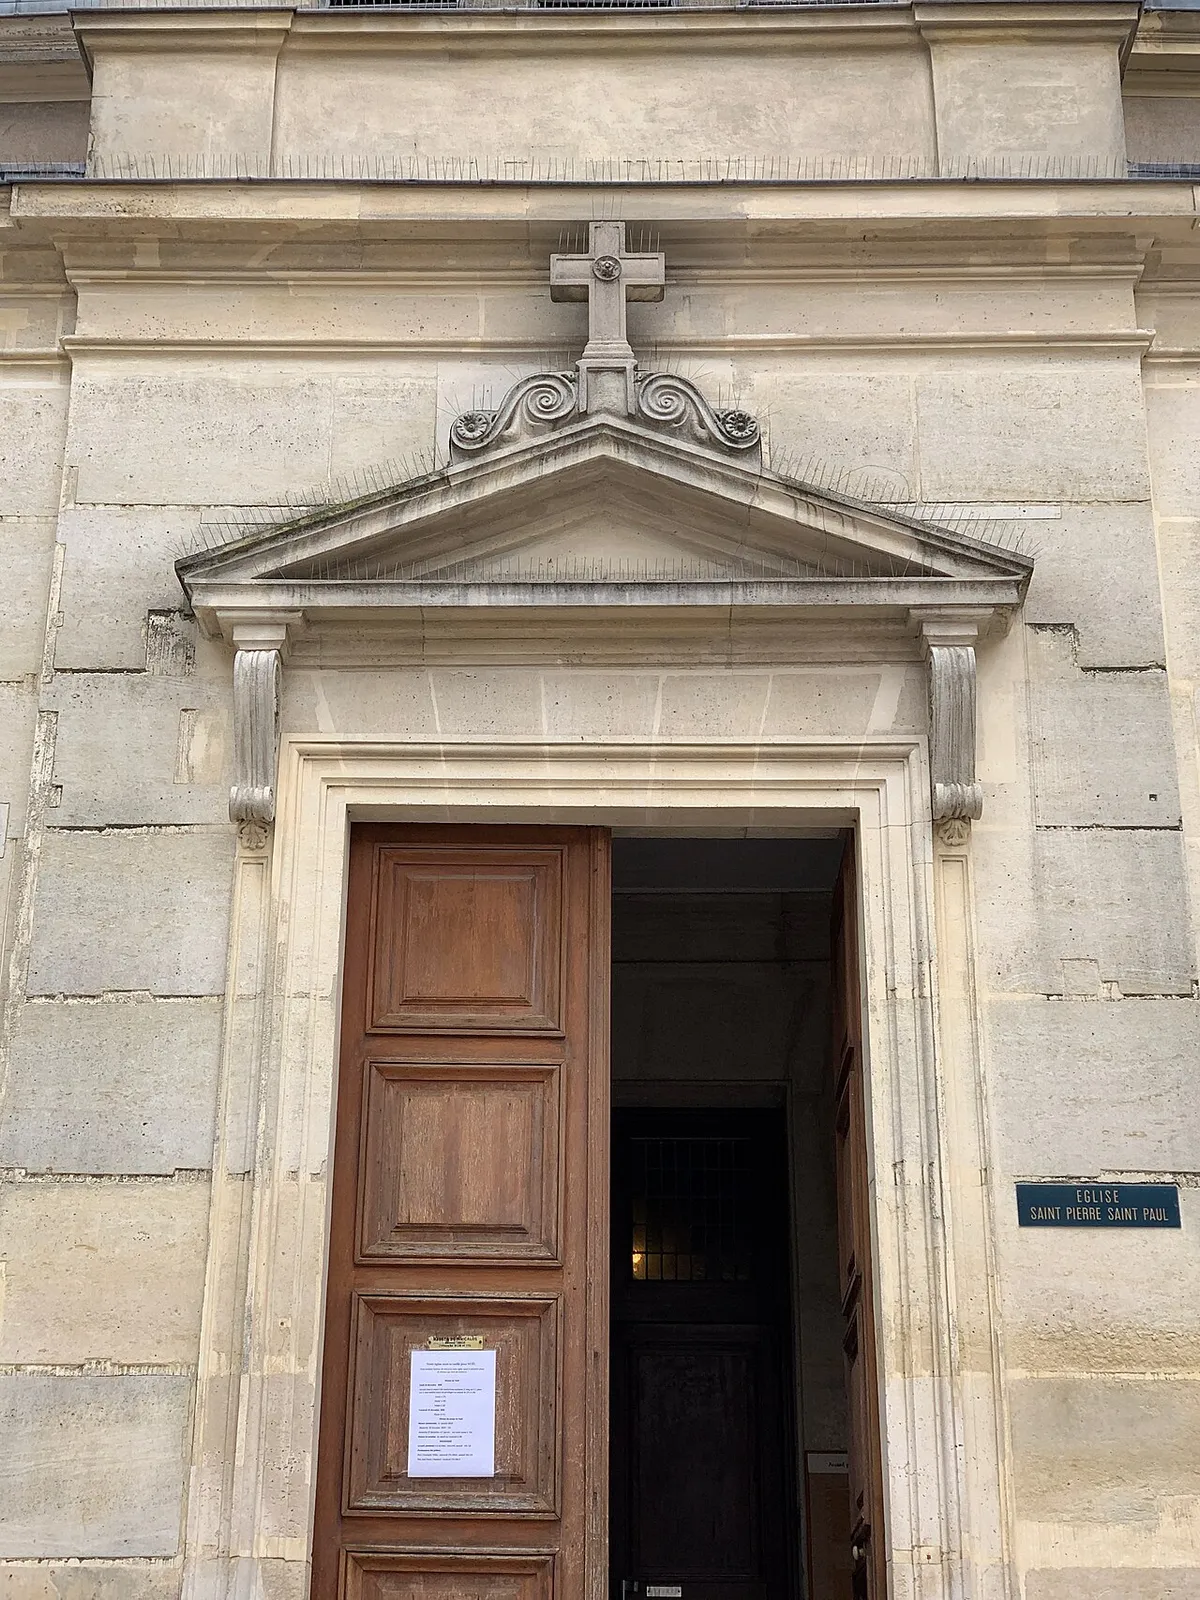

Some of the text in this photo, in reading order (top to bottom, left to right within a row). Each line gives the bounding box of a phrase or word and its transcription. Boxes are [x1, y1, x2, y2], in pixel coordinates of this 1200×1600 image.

[1076, 1189, 1120, 1203] EGLISE
[1030, 1206, 1169, 1221] SAINT PIERRE SAINT PAUL
